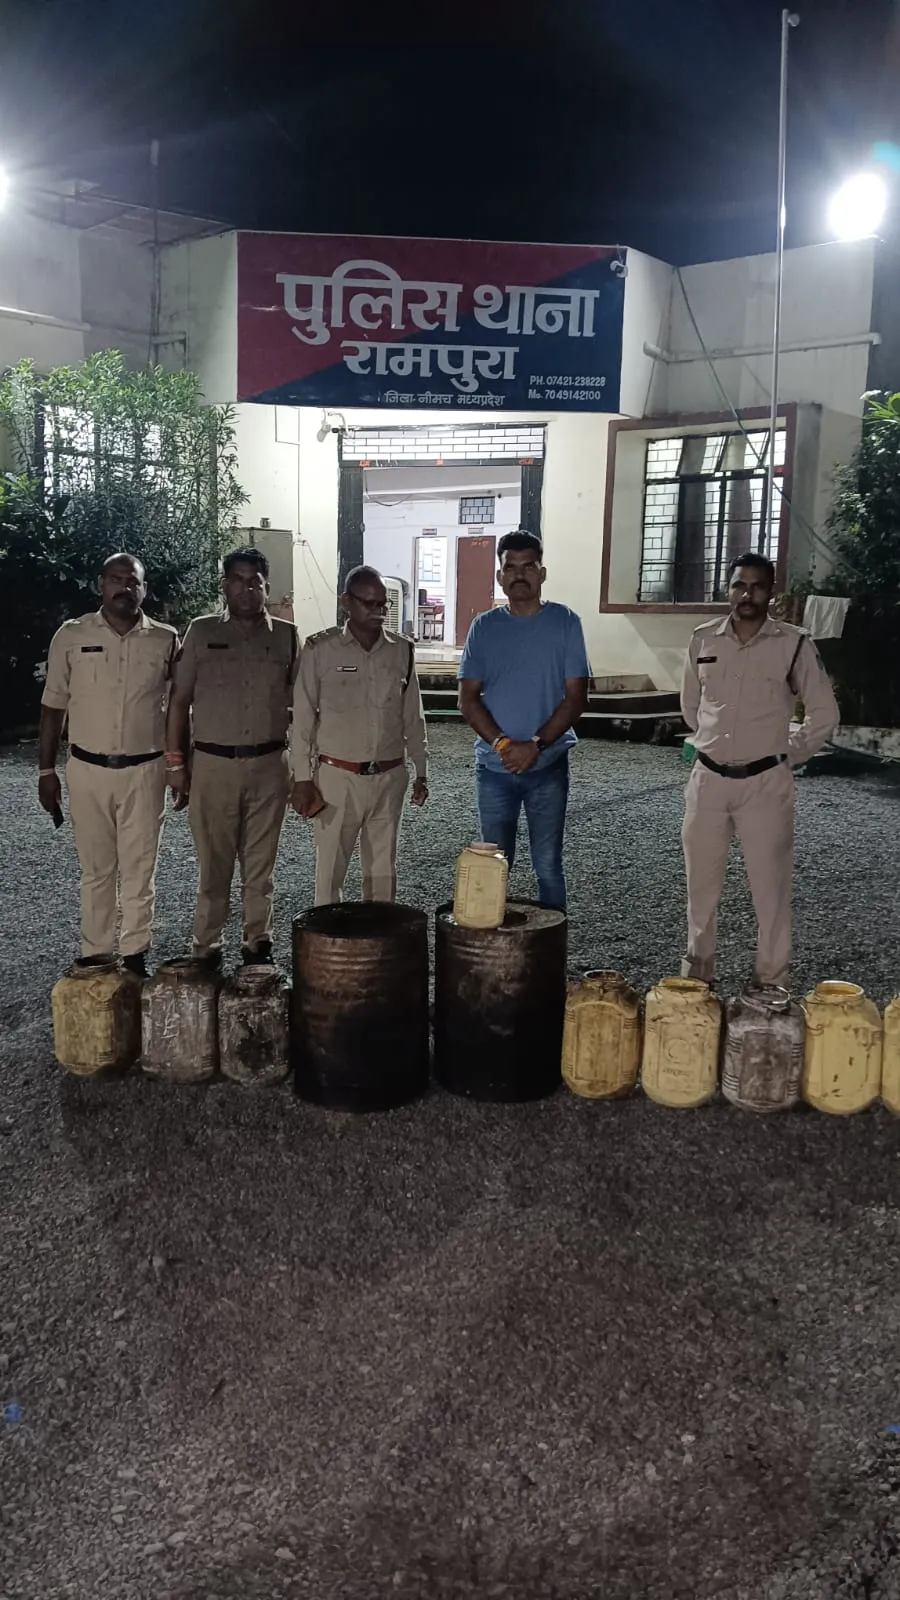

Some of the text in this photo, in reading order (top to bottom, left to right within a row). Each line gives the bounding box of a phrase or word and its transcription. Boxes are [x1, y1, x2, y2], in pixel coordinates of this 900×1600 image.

[275, 259, 600, 346] पुलिस थाना
[340, 340, 520, 394] रामपुरा
[457, 392, 506, 407] मध्यप्रदेश
[545, 389, 601, 401] 7049142100
